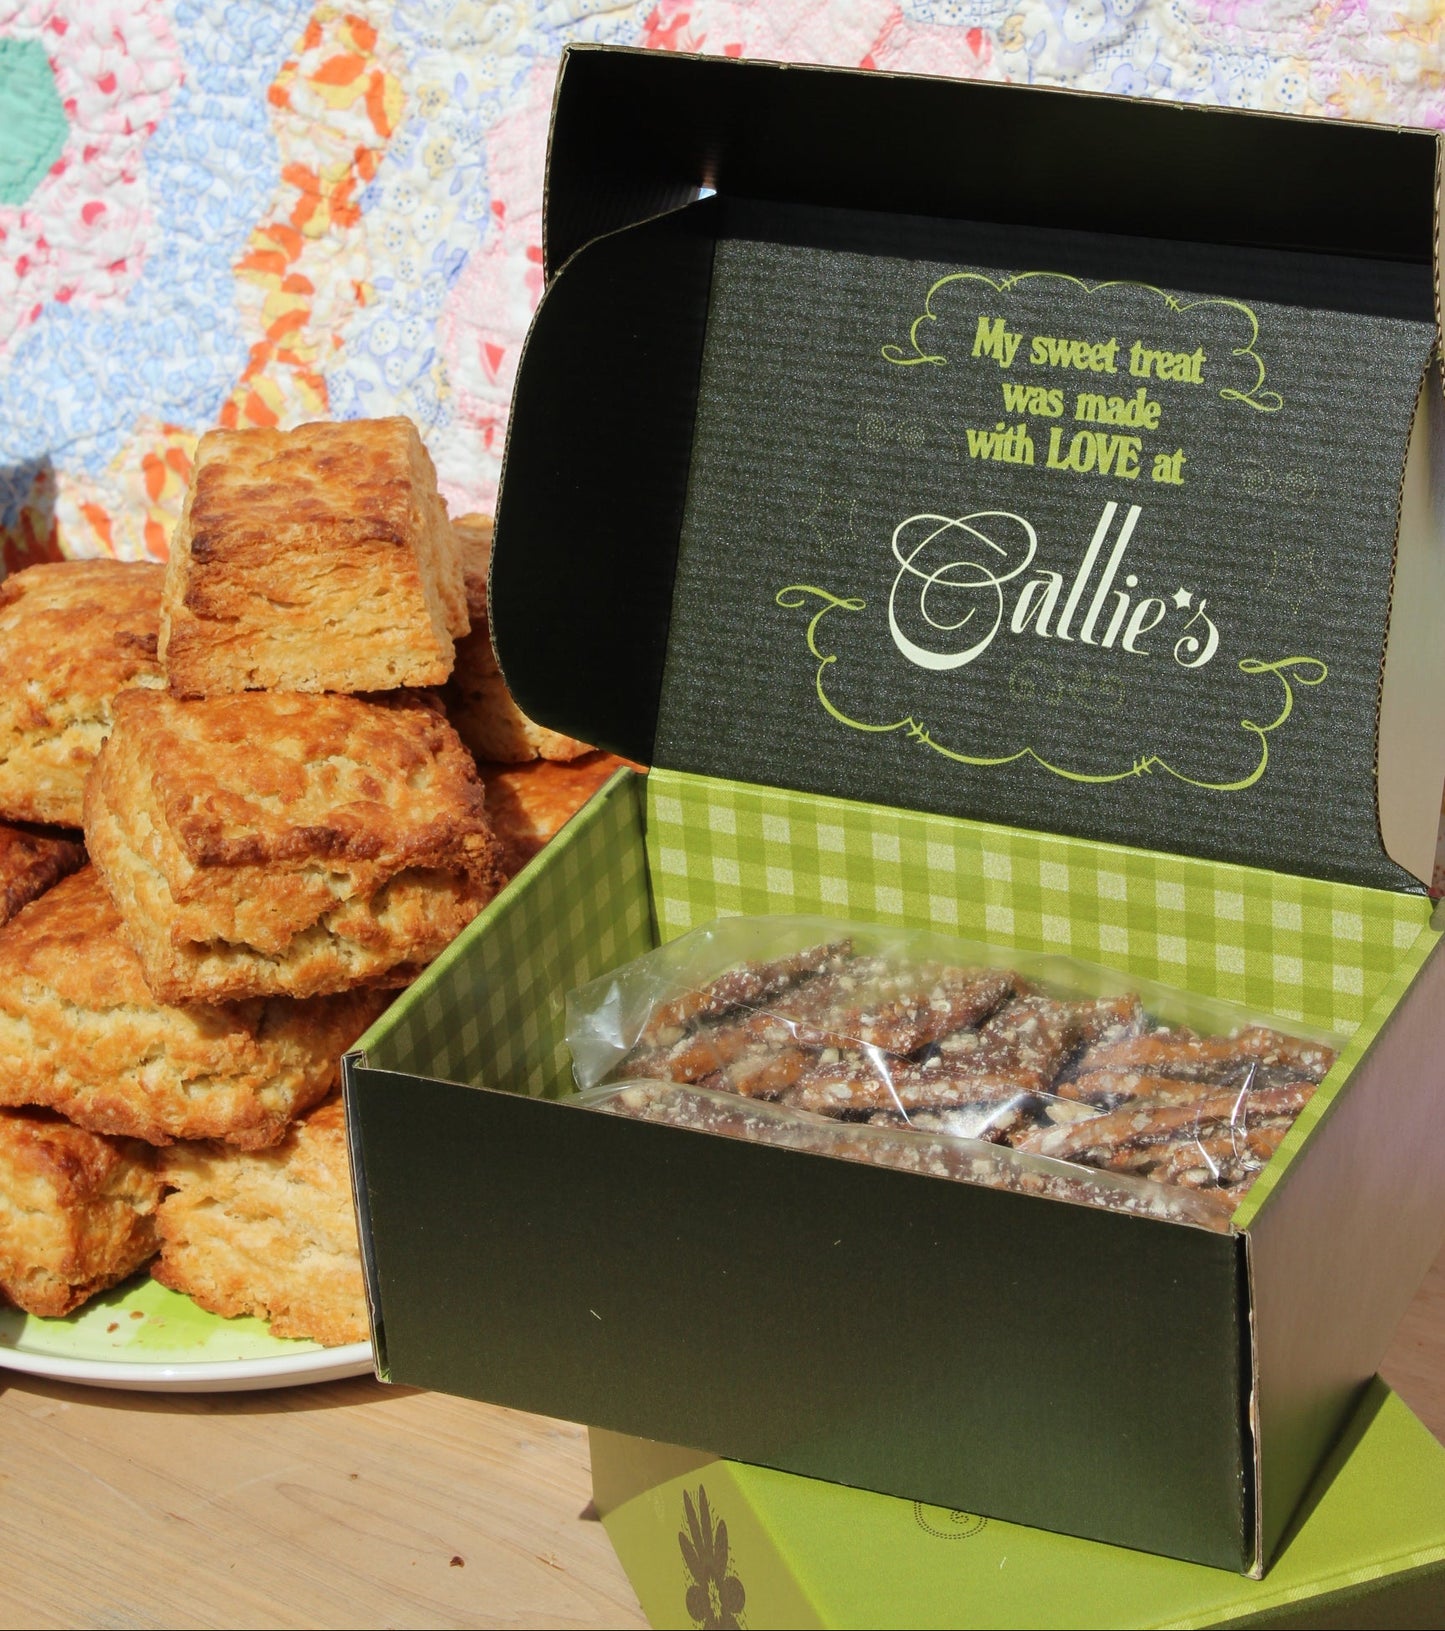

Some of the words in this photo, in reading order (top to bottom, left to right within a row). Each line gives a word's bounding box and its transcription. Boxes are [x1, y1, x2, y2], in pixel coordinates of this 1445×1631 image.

[971, 316, 1023, 368] My
[1030, 332, 1120, 375] sweet
[1129, 340, 1206, 384] treat
[1002, 381, 1065, 417] was
[1075, 387, 1162, 430] made
[966, 422, 1035, 466] with
[1046, 427, 1143, 480] LOVE
[1151, 447, 1187, 486] at
[888, 500, 1220, 671] Callie's
